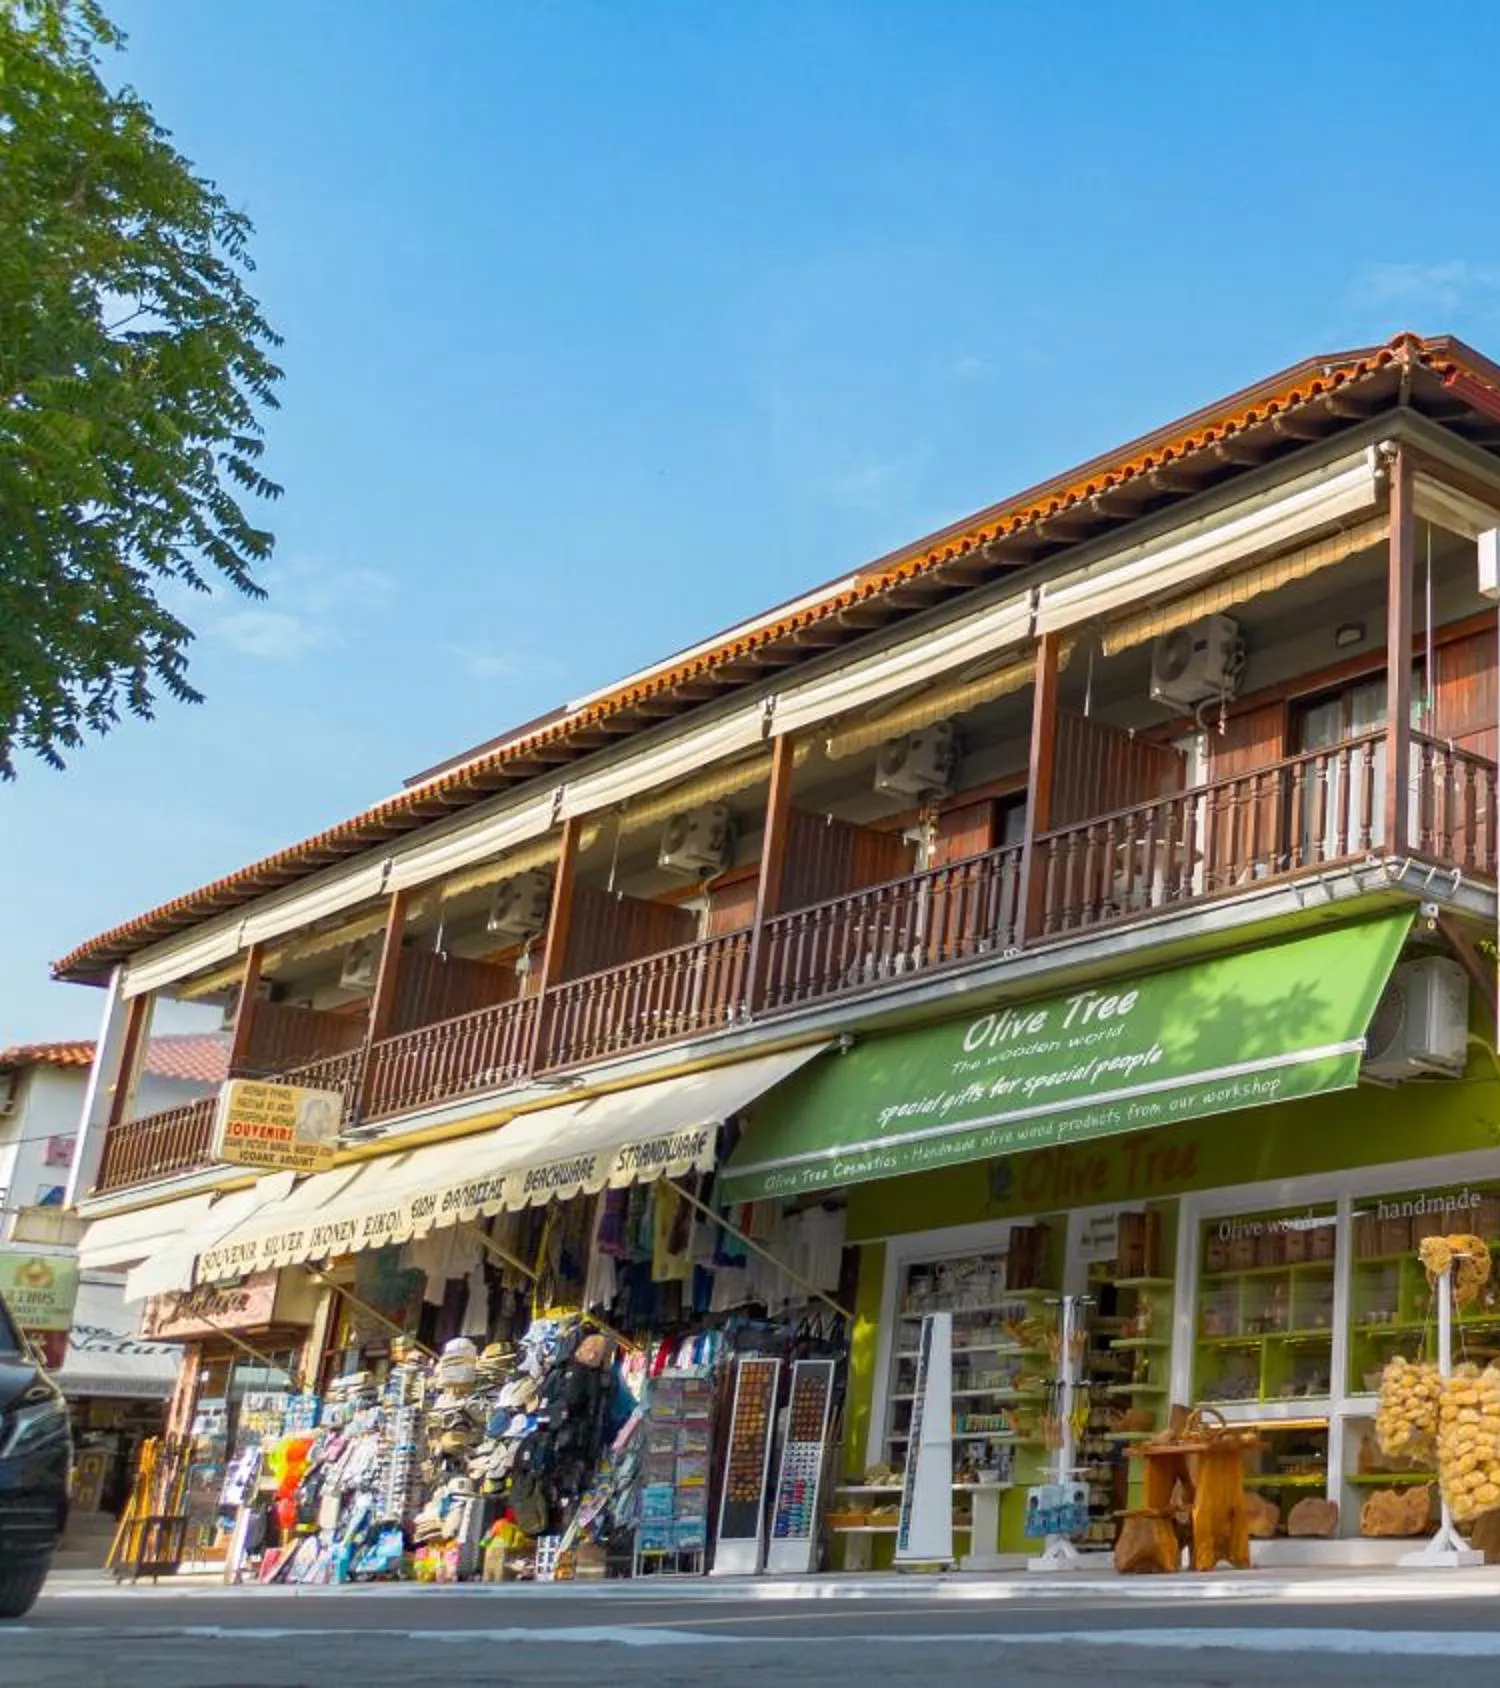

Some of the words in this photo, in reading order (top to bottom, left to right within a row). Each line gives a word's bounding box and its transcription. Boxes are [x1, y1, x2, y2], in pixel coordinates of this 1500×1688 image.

[952, 1059, 981, 1075] The
[987, 1040, 1060, 1067] wooden
[1069, 1023, 1125, 1048] world
[963, 1008, 1049, 1052] Olive
[1062, 989, 1139, 1029] Tree
[876, 1091, 943, 1128] special
[939, 1081, 985, 1117] gifts
[988, 1074, 1022, 1099] for
[1021, 1057, 1097, 1099] special
[1090, 1043, 1164, 1084] people
[801, 1167, 828, 1185] Tree
[911, 1136, 976, 1161] Handmade
[981, 1128, 1014, 1147] olive
[1016, 1122, 1054, 1142] wood
[1056, 1109, 1122, 1141] products
[1127, 1103, 1163, 1121] from
[1169, 1094, 1197, 1111] our
[1202, 1076, 1283, 1105] workshop
[1120, 1134, 1201, 1191] Tree
[1219, 1219, 1263, 1242] Olive
[1377, 1188, 1482, 1221] handmade
